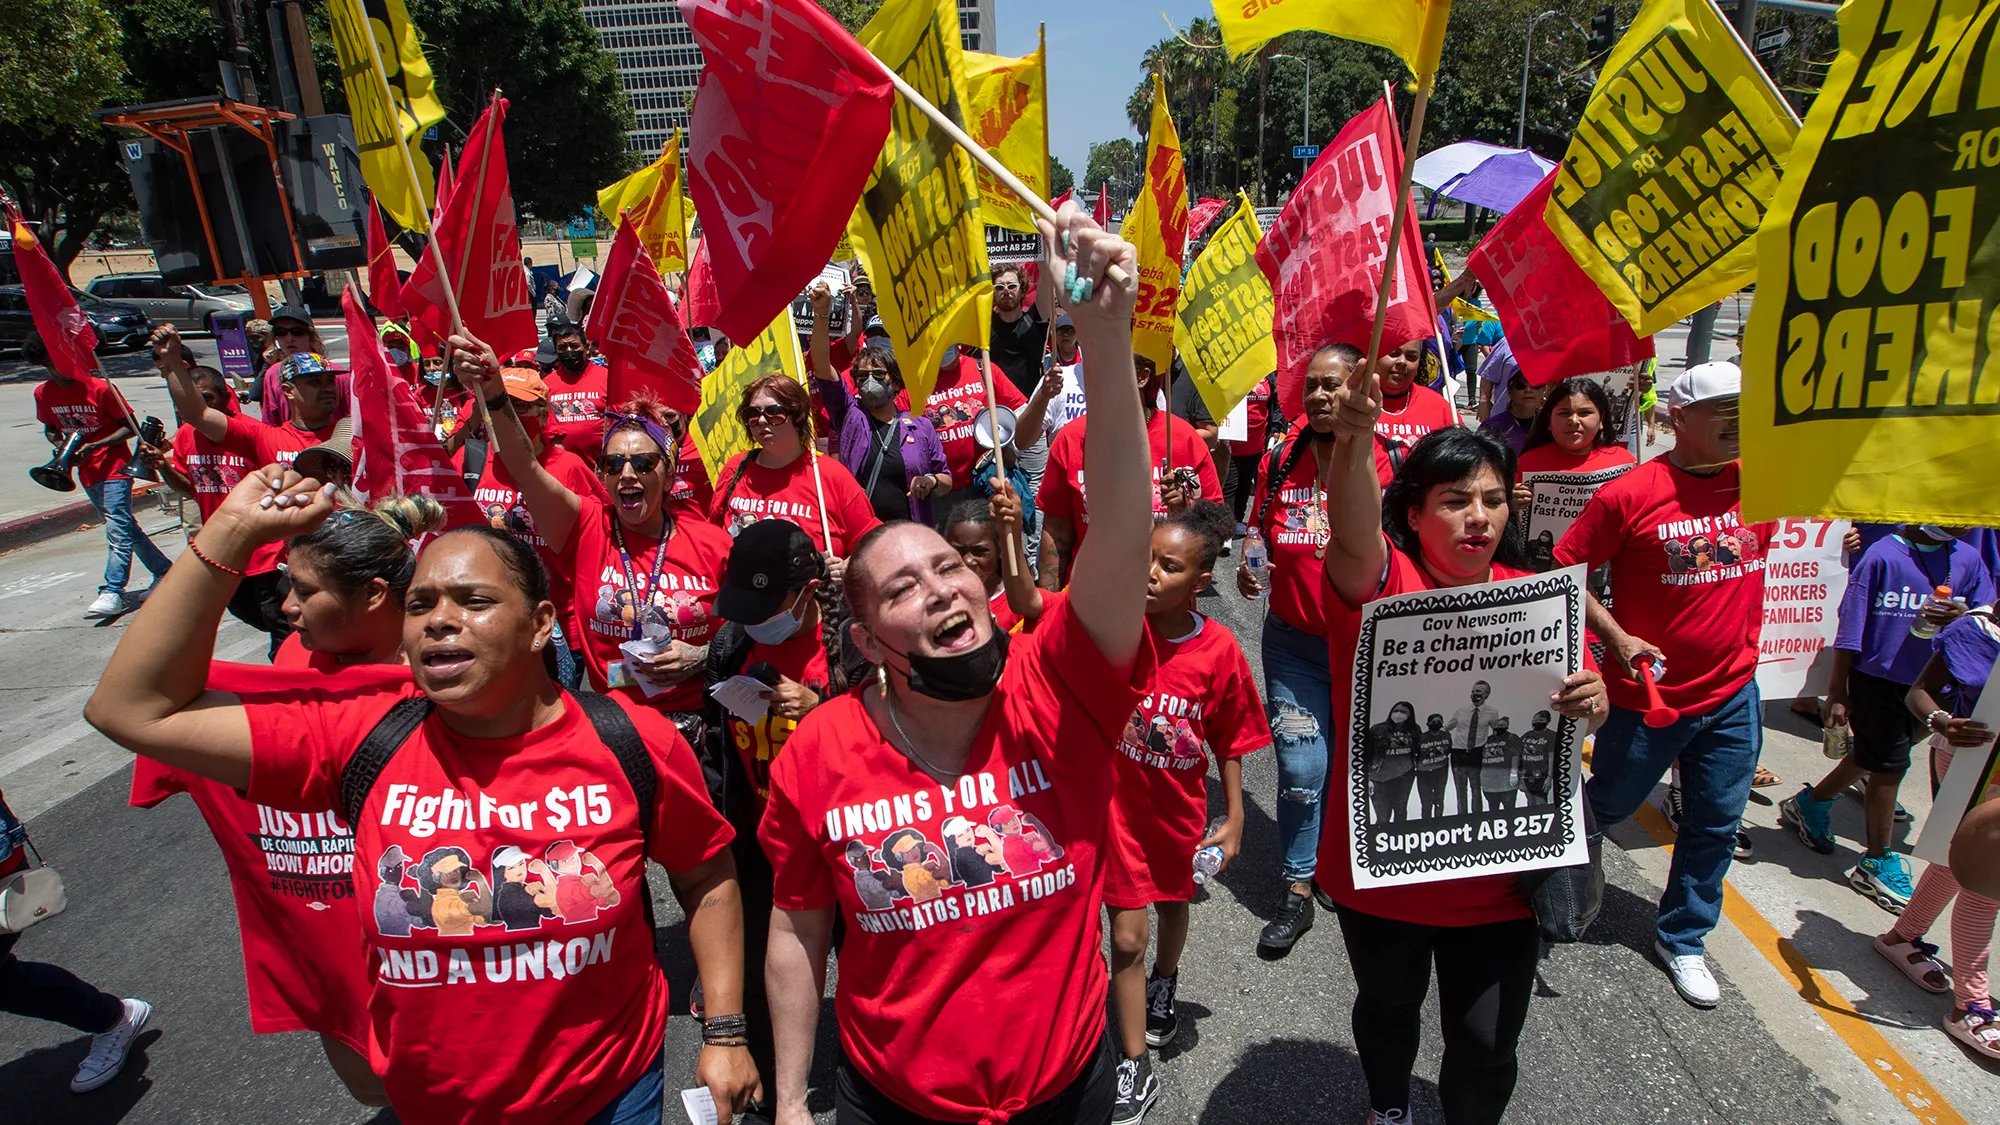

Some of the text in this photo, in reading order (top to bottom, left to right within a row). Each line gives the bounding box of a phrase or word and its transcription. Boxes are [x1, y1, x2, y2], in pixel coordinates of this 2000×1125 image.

[321, 142, 348, 210] WANCO
[1009, 243, 1020, 252] AB
[1021, 242, 1036, 252] 257
[573, 391, 585, 400] FOR
[586, 391, 600, 399] ALL
[948, 387, 964, 400] For
[964, 381, 984, 396] $15
[83, 404, 98, 415] ALL
[1392, 423, 1413, 435] FOR
[213, 454, 227, 465] FOR
[229, 454, 246, 467] ALL
[1537, 494, 1550, 504] Be
[1553, 497, 1560, 505] a
[1558, 486, 1576, 495] Gov
[767, 498, 789, 515] FOR
[791, 502, 812, 518] ALL
[1533, 504, 1557, 517] fast
[1657, 511, 1740, 541] UNIONS FOR
[1720, 565, 1743, 581] PARA
[1769, 561, 1819, 579] WAGES
[683, 575, 710, 591] ALL
[1422, 610, 1527, 632] Gov Newsom:
[1762, 606, 1823, 625] FAMILIES
[1382, 619, 1563, 657] Be a champion of
[1760, 637, 1826, 655] ALIFORNIA
[1376, 647, 1565, 679] fast food workers
[1158, 693, 1188, 717] FOR
[1145, 753, 1171, 769] PARA
[826, 759, 1052, 842] UNIONS FOR ALL
[381, 783, 613, 838] Fight For $15
[257, 803, 353, 838] JUSTIC
[1375, 813, 1555, 854] Support AB 257
[260, 837, 275, 851] DE
[275, 839, 319, 855] COMIDA
[266, 853, 355, 875] NOW! AHOR
[855, 863, 1077, 934] SINDICATOS PARA TODOS
[377, 927, 617, 985] AND A UNION
